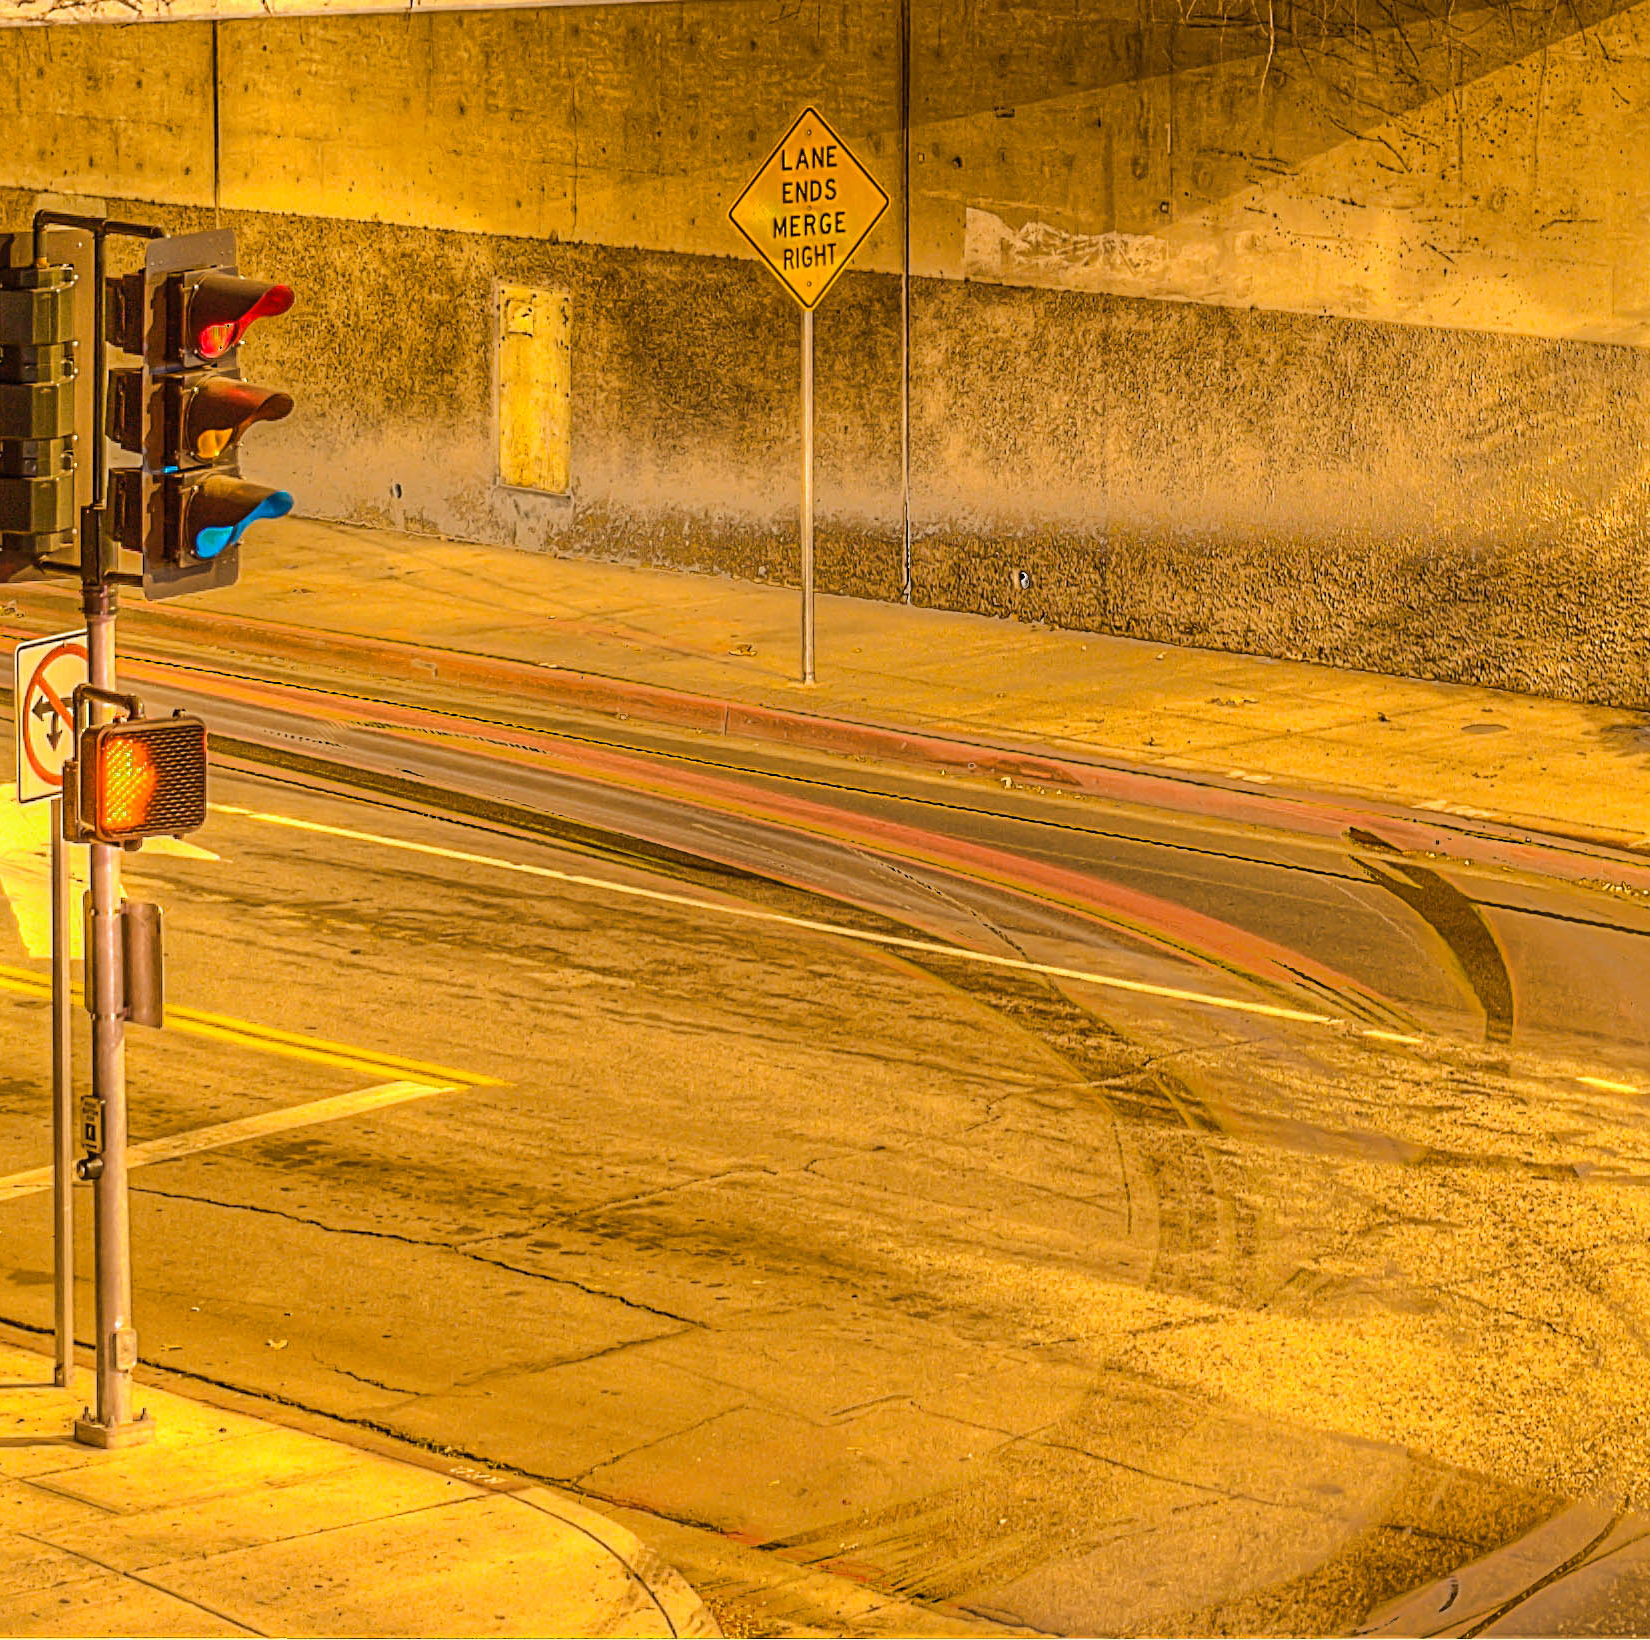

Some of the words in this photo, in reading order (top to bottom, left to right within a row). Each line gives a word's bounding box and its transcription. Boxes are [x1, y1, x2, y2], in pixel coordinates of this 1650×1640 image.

[781, 145, 838, 171] LANE
[782, 178, 837, 204] ENDS
[773, 211, 846, 239] MERGE
[783, 242, 837, 271] RIGHT
